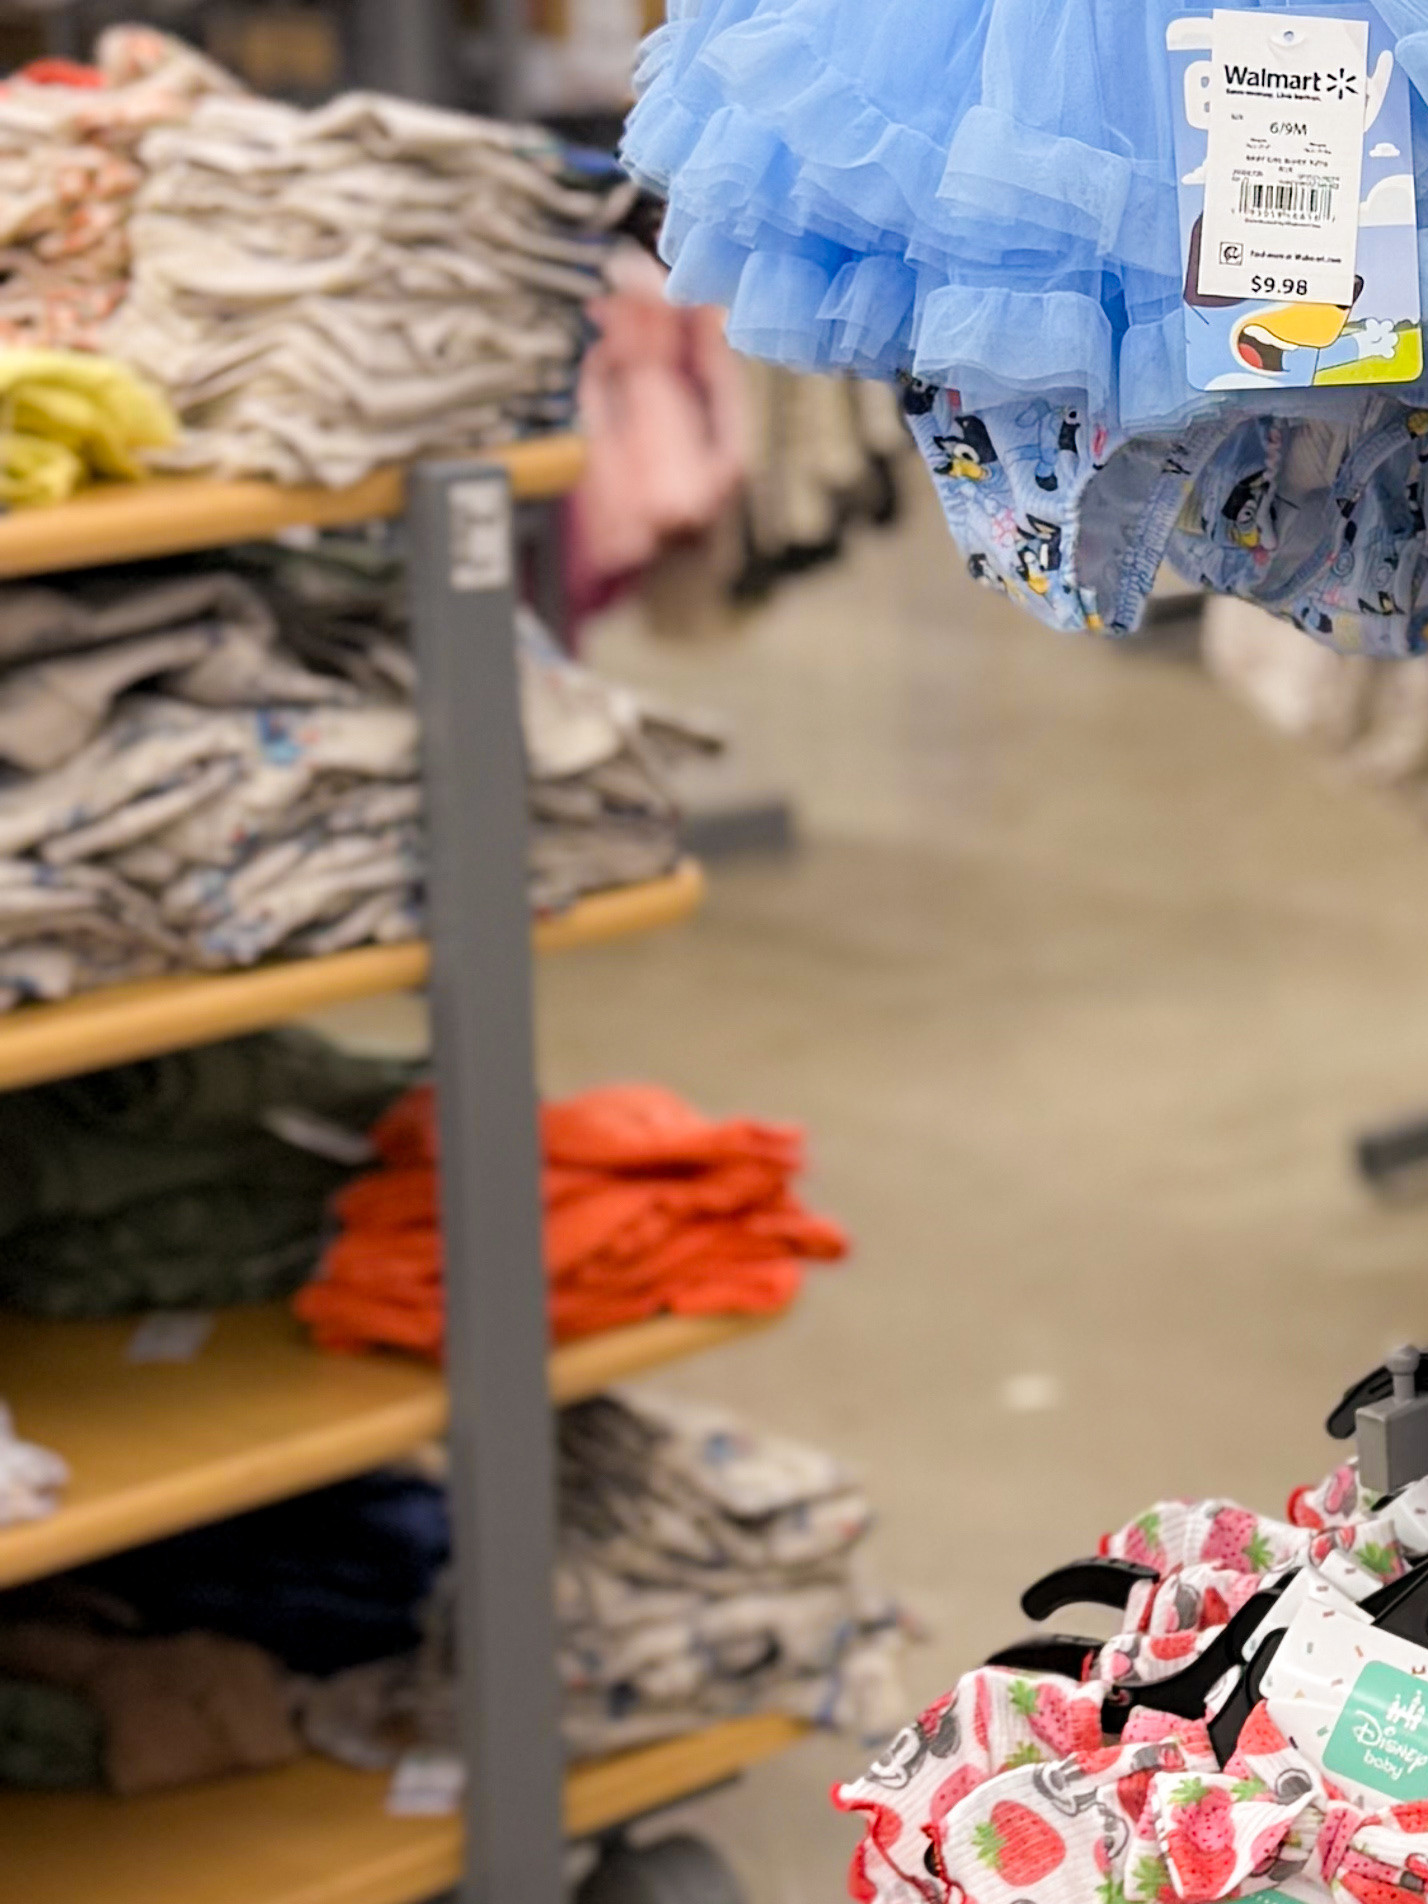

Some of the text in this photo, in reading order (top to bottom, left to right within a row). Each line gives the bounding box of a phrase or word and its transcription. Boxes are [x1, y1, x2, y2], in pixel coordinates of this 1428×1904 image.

[1224, 64, 1321, 92] Walmart
[1269, 121, 1308, 136] 6/9M
[1251, 274, 1308, 296] $9.98
[1353, 1709, 1428, 1774] Disney
[1364, 1749, 1404, 1782] baby
